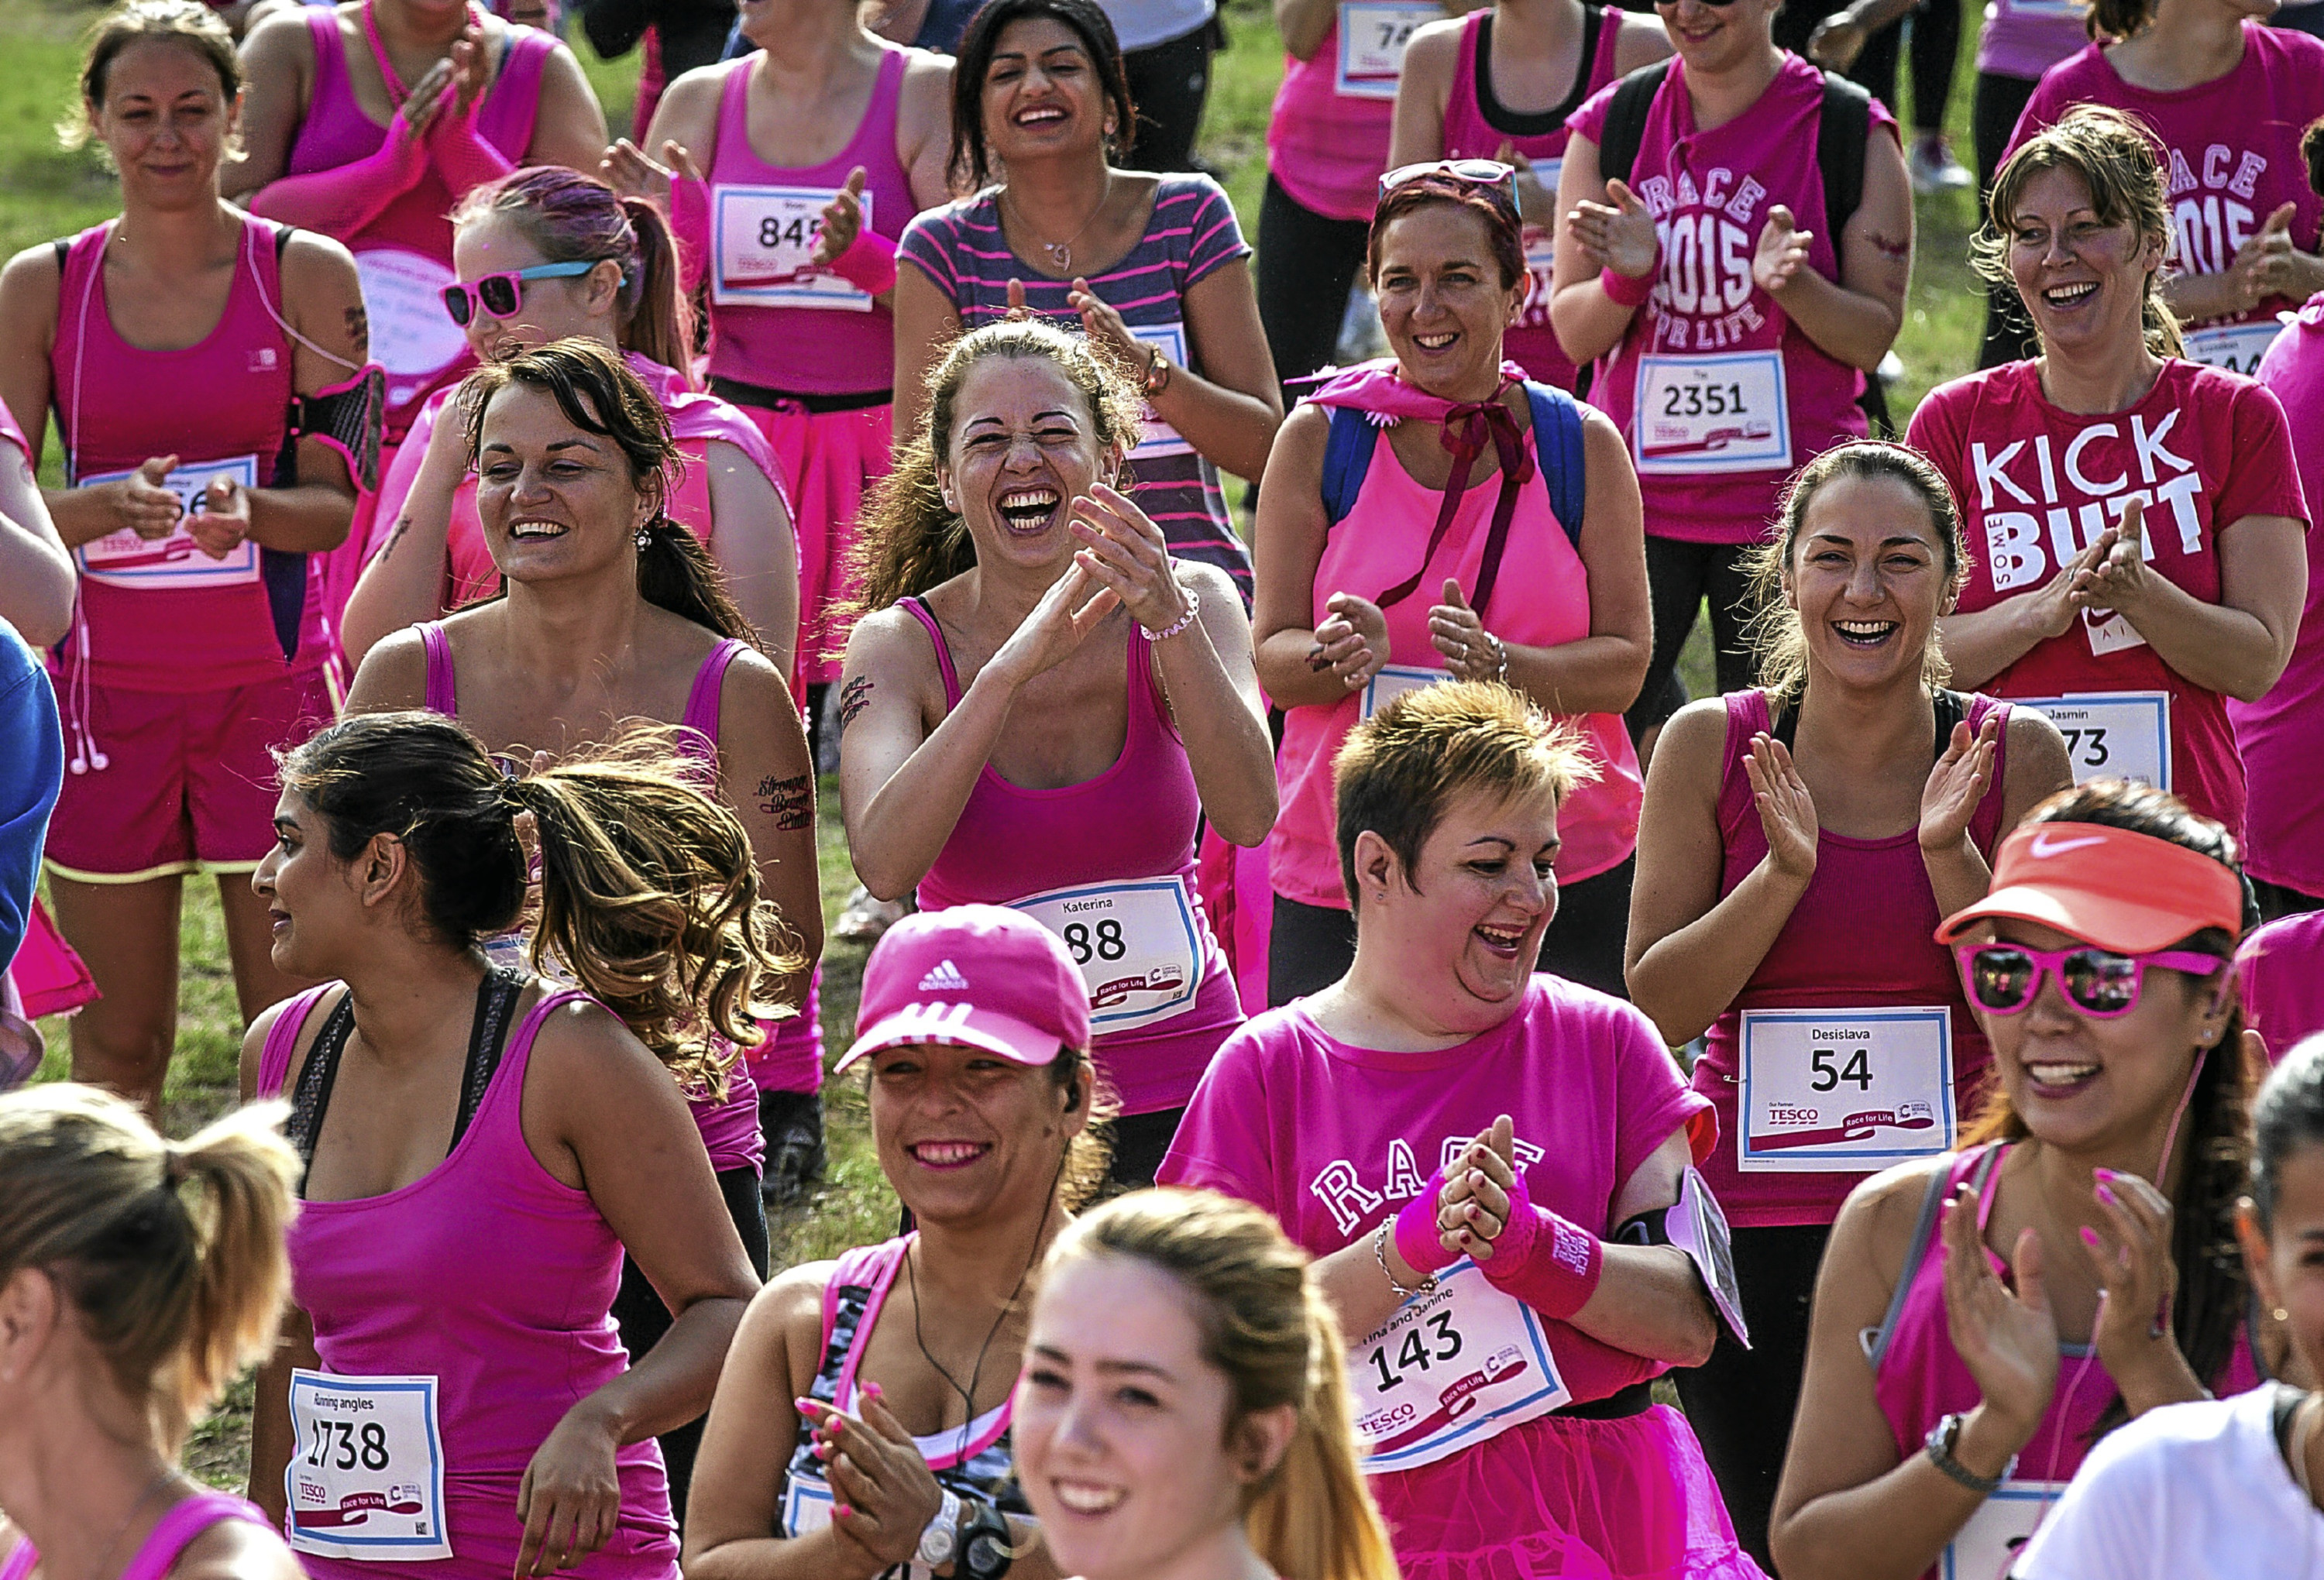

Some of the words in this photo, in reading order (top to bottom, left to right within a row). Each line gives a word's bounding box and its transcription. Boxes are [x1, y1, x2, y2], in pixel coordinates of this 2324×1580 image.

[1639, 167, 1767, 224] RACE
[1696, 301, 1765, 349] LIFE
[1665, 383, 1746, 414] 2351
[1972, 407, 2194, 510] KICK
[1984, 472, 2202, 592] BUTT
[1988, 517, 2011, 585] SOME
[2049, 709, 2089, 720] Jasmin
[1063, 898, 1113, 913] Katerina
[1064, 919, 1126, 965] 88
[1100, 984, 1117, 995] Race
[1812, 1029, 1871, 1040] Desislava
[1811, 1049, 1873, 1091] 54
[1769, 1109, 1818, 1120] TESCO
[1846, 1117, 1864, 1127] Race
[1391, 1311, 1413, 1331] and
[1415, 1289, 1453, 1317] Janine
[1369, 1309, 1462, 1393] 143
[314, 1393, 338, 1411] Running
[339, 1397, 374, 1413] angles
[1442, 1390, 1459, 1406] Race
[1357, 1403, 1415, 1432] TESCO
[308, 1419, 390, 1472] 1738
[299, 1482, 325, 1499] TESCO
